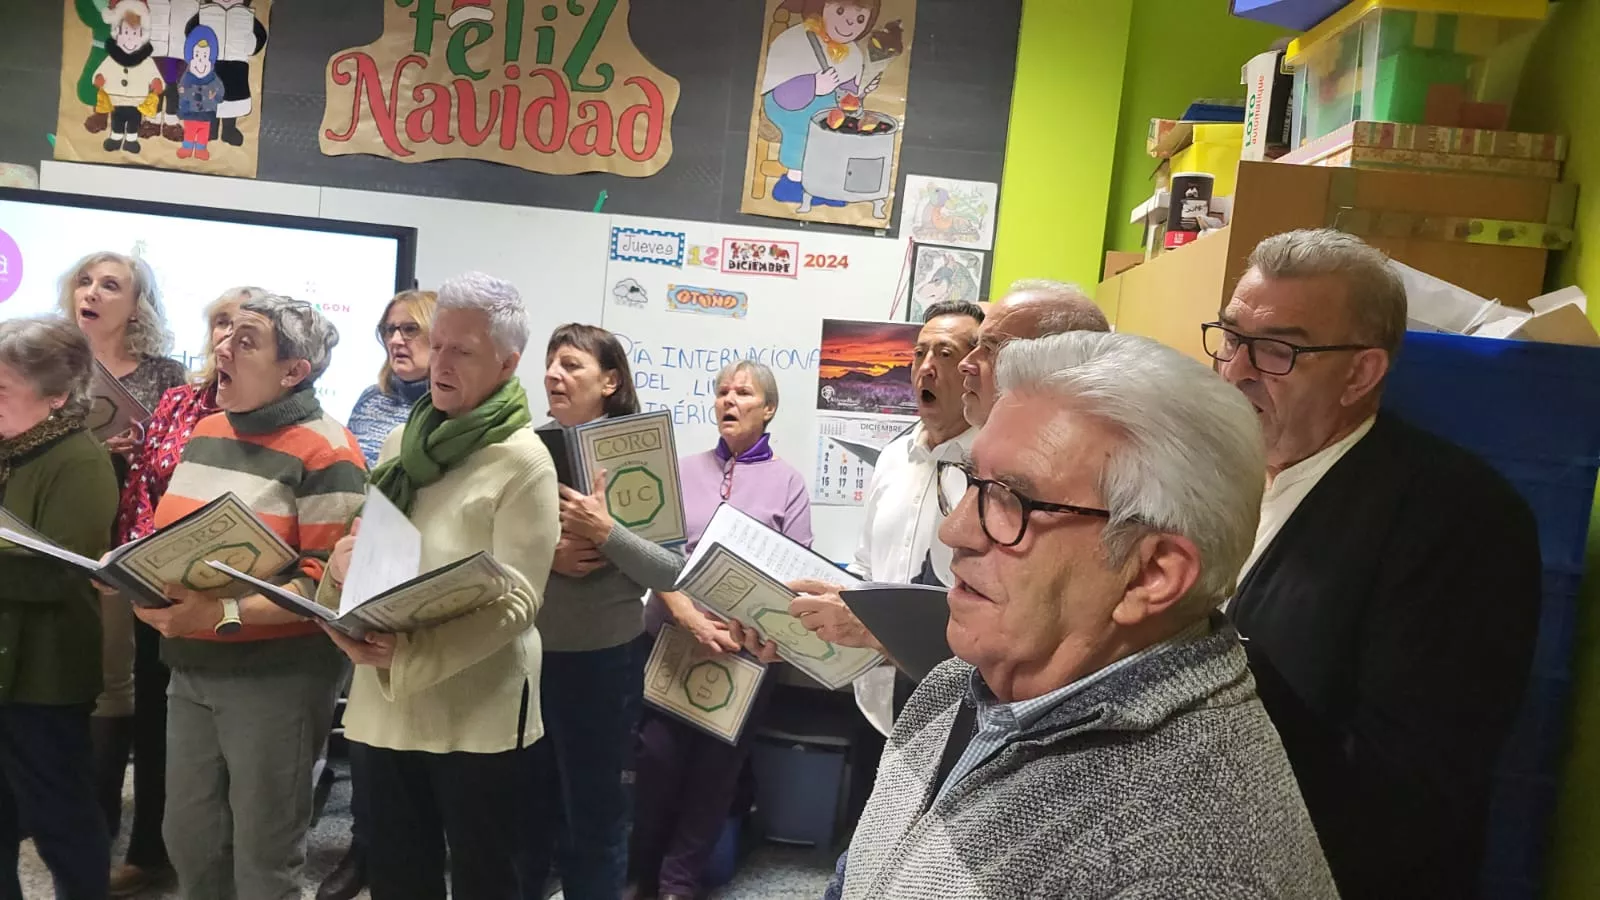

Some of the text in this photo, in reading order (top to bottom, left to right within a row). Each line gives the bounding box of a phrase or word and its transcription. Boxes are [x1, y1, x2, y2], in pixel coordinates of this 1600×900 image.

[325, 51, 665, 162] Navidad
[1245, 94, 1256, 148] LOTO
[622, 234, 674, 256] Jueves
[728, 259, 791, 273] DICIEMBRE
[803, 253, 849, 269] 2024
[661, 345, 821, 372] INTERNACIONA
[634, 371, 670, 390] DEL
[860, 423, 903, 433] DICIEMBRE
[596, 431, 658, 457] CORO
[821, 476, 830, 487] 16
[839, 477, 847, 488] 17
[840, 465, 848, 476] 10
[856, 467, 864, 477] 11
